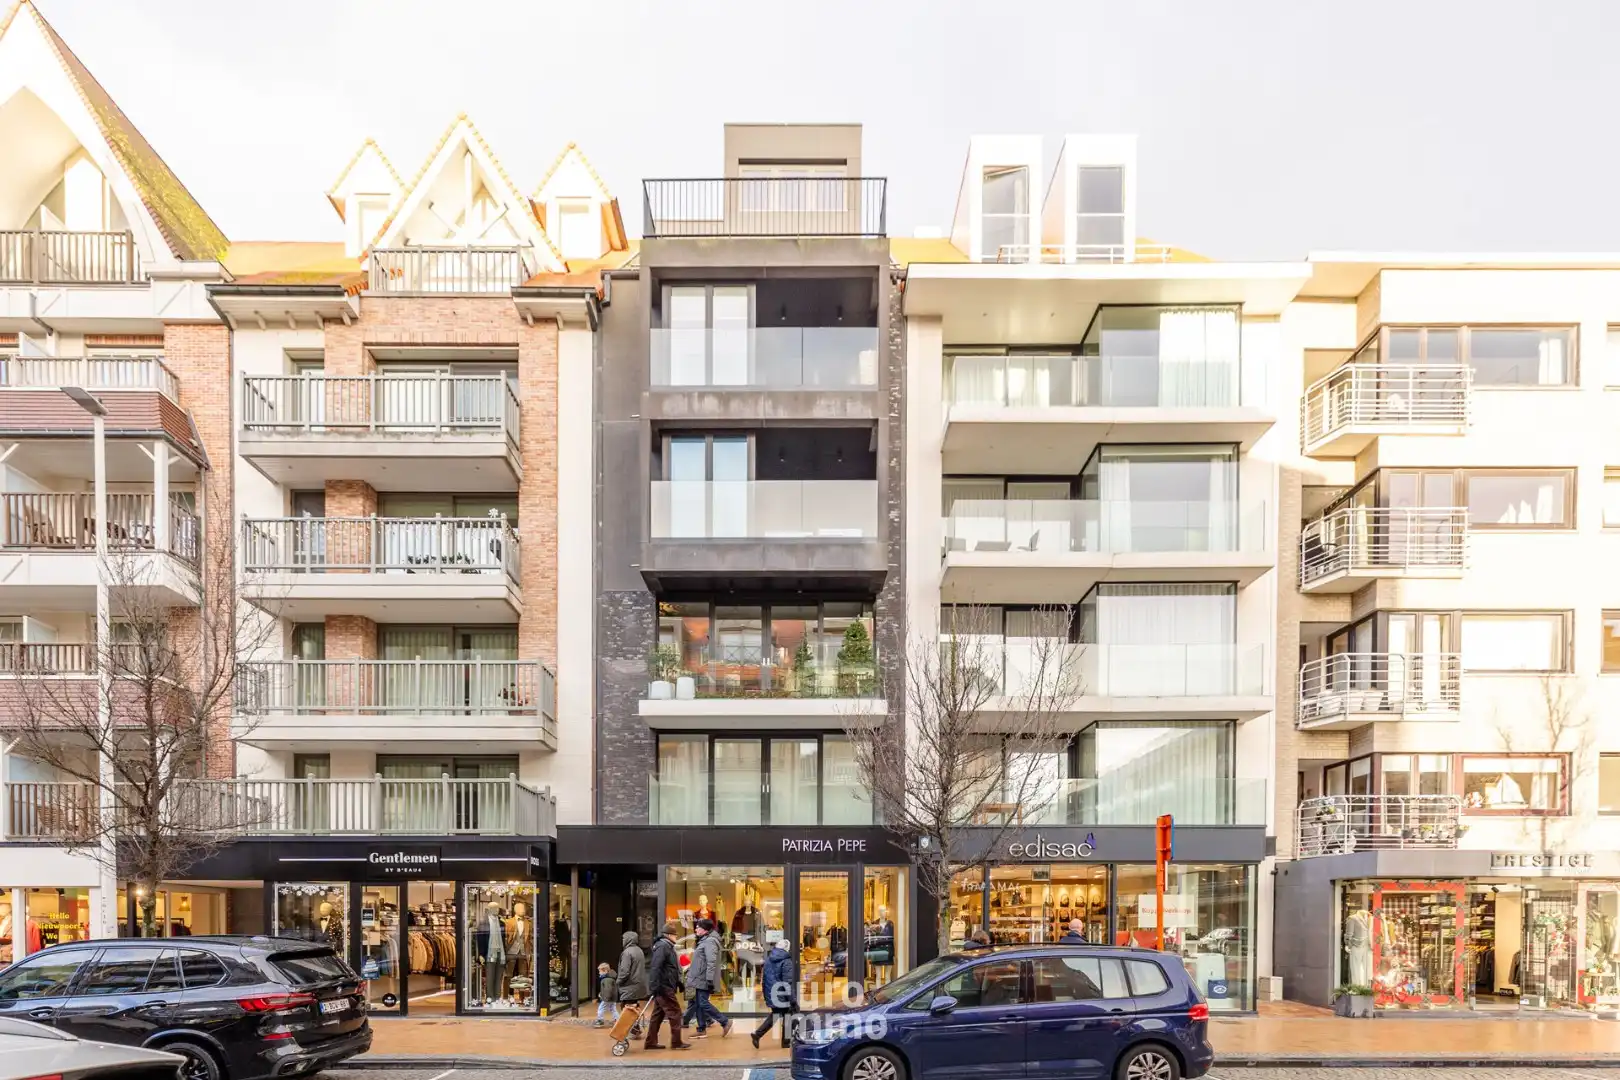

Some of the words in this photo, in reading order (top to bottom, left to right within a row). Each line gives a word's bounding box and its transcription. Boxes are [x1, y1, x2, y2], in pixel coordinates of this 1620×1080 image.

[782, 838, 833, 852] PATRIZIA
[838, 838, 866, 852] PEPE
[1009, 833, 1092, 858] edisac
[369, 851, 438, 864] Gentlemen
[1490, 853, 1595, 868] PRESTIGE
[48, 912, 70, 920] Hello
